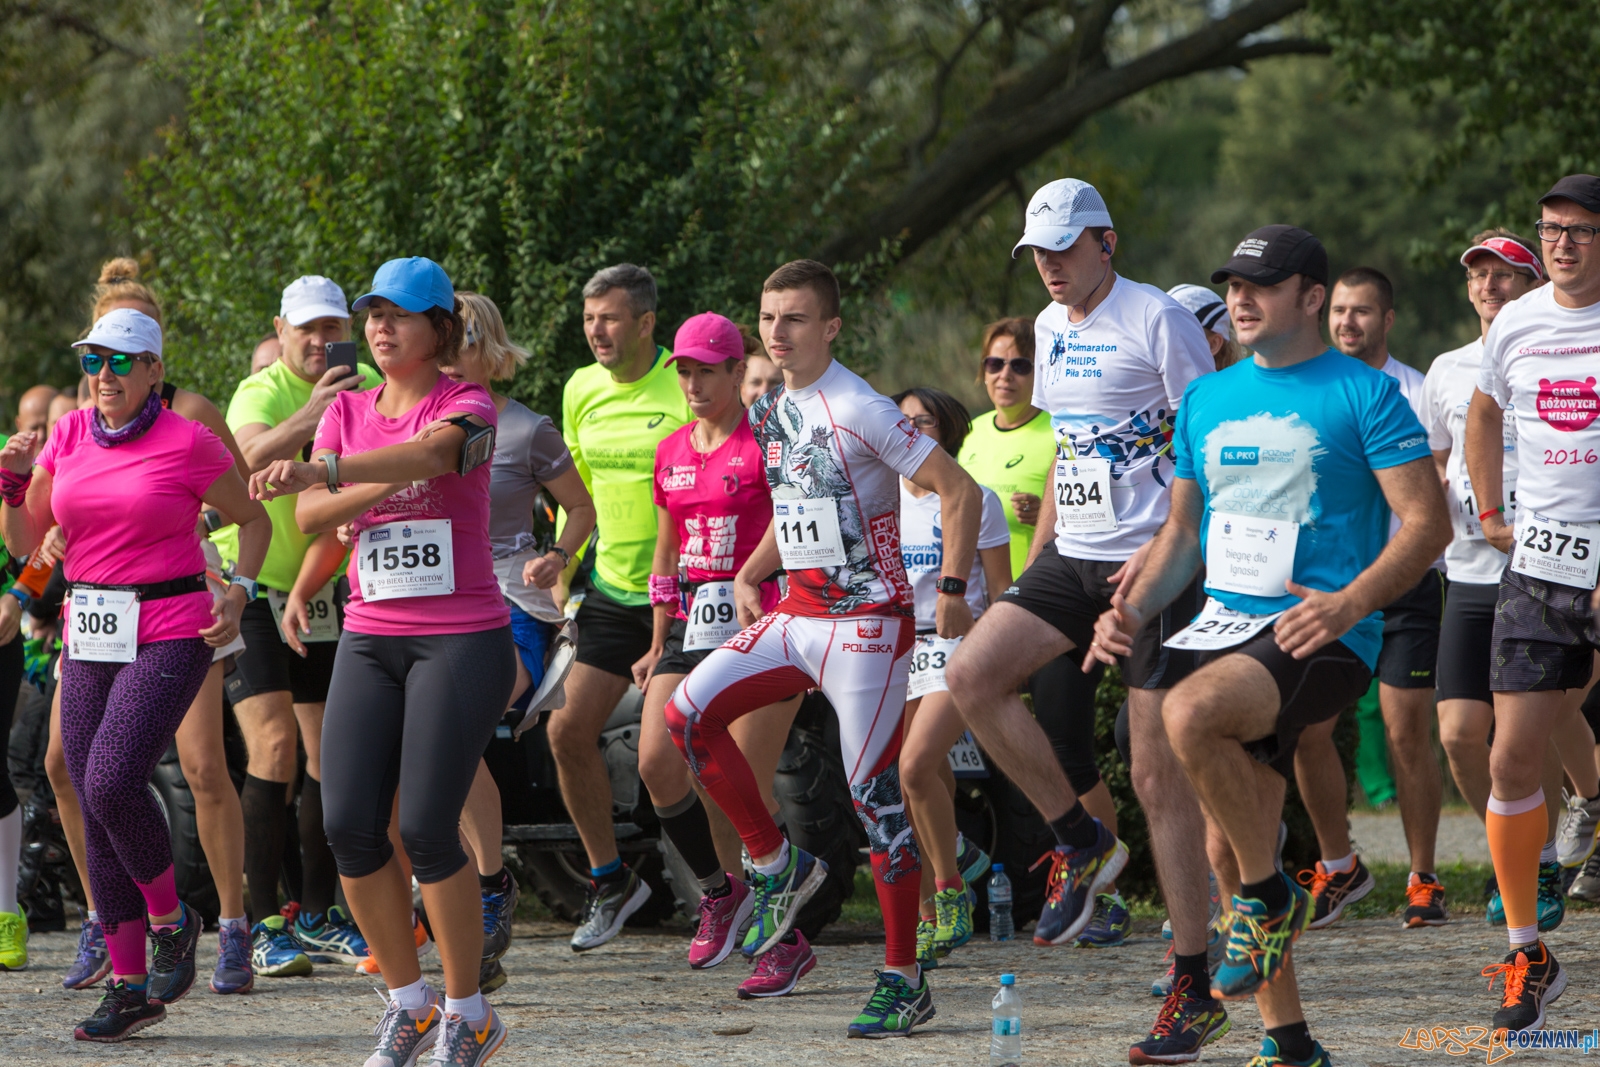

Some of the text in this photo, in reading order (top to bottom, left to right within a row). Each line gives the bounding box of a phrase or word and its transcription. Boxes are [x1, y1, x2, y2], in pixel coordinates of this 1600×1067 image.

[1068, 330, 1080, 339] 26.
[1067, 342, 1117, 352] Półmaraton
[1066, 357, 1097, 366] PHILIPS
[1065, 368, 1102, 378] Piła 2016
[1552, 387, 1580, 397] GANG
[1540, 397, 1597, 410] RÓŻOWYCH
[1548, 410, 1589, 421] MISIÓW
[1224, 451, 1256, 460] 16. PKO
[1543, 449, 1598, 465] 2016
[1225, 475, 1252, 485] SIŁA
[1057, 481, 1102, 506] 2234
[1233, 488, 1289, 500] ODWAGA
[601, 500, 635, 520] 607
[780, 520, 819, 543] 111
[902, 543, 936, 551] ieczorne
[1524, 525, 1590, 560] 2375
[804, 547, 835, 556] LECHITÓW
[872, 518, 900, 581] HOBBY
[367, 543, 441, 572] 1558
[1226, 548, 1268, 564] biegnę dla
[1537, 559, 1552, 568] BIEG
[1553, 563, 1588, 575] LECHITÓW
[387, 577, 403, 585] BIEG
[405, 573, 444, 583] LECHITÓW
[693, 603, 738, 625] 109
[77, 611, 117, 635] 308
[842, 643, 893, 653] POLSKA
[962, 750, 980, 767] 48
